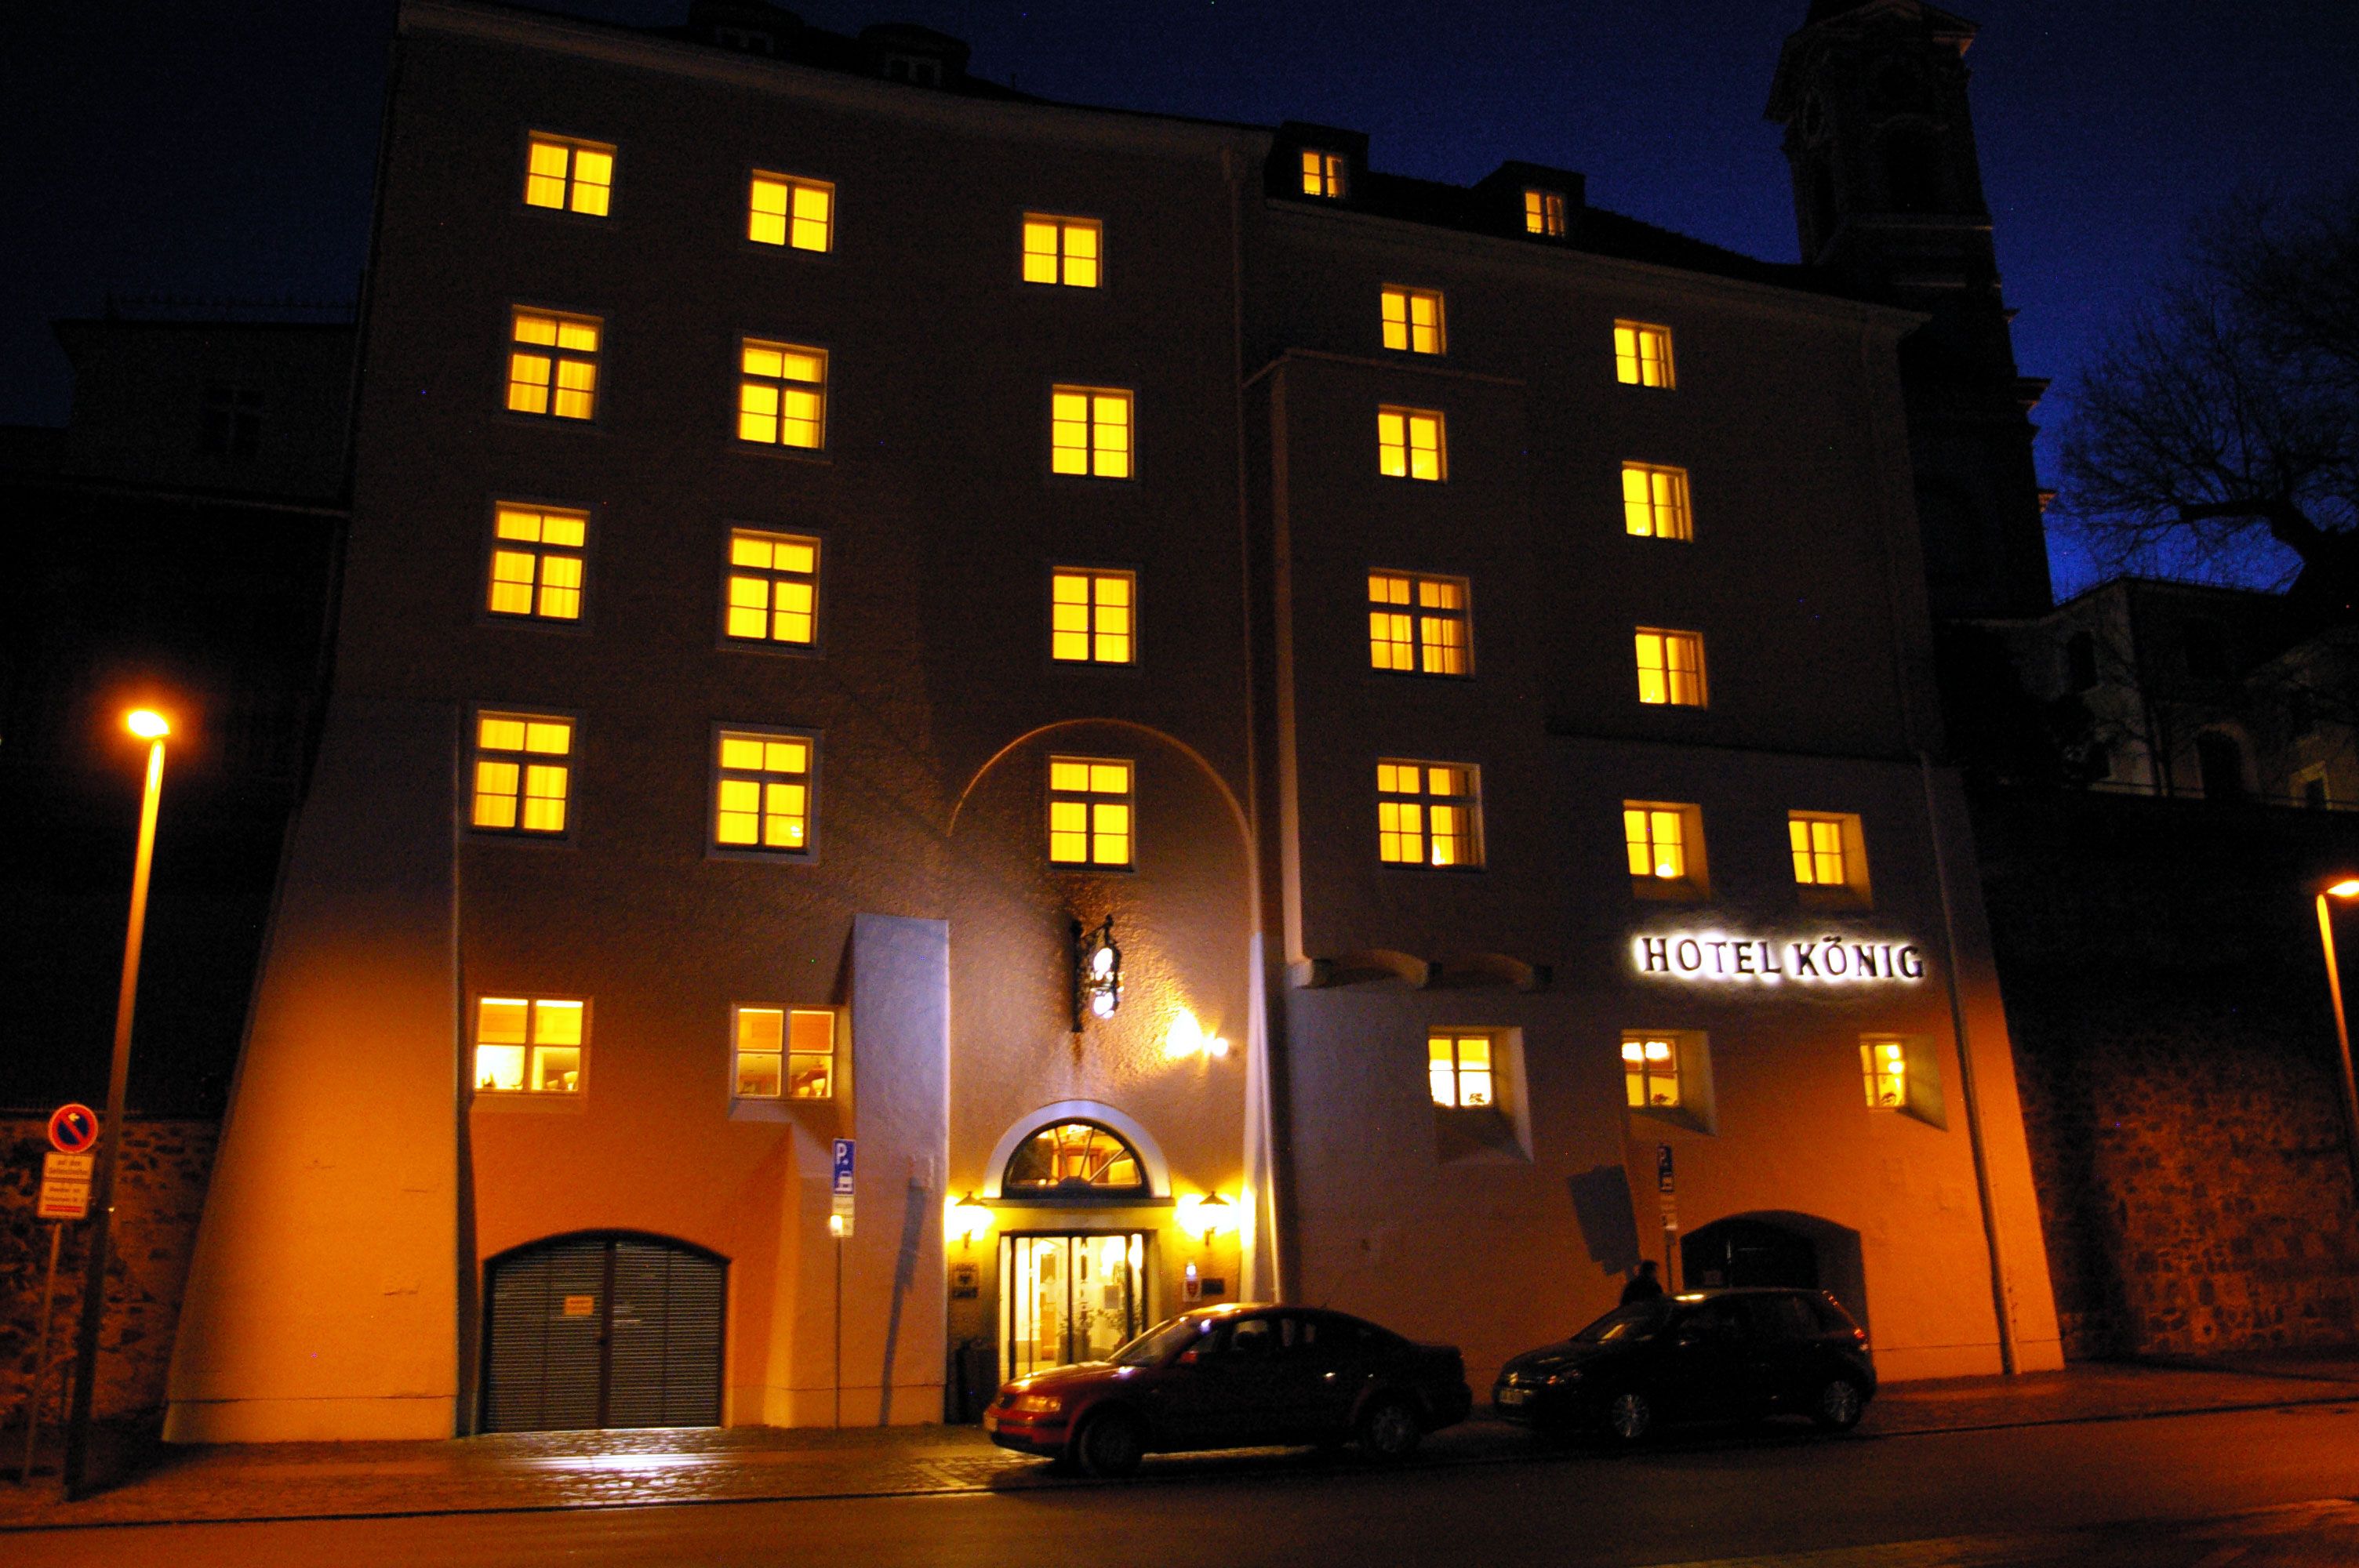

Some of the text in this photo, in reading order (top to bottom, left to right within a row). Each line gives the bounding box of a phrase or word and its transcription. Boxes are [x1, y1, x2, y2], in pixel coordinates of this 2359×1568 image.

[1641, 935, 1924, 978] HOTEL KÖNIG
[836, 1142, 847, 1165] P
